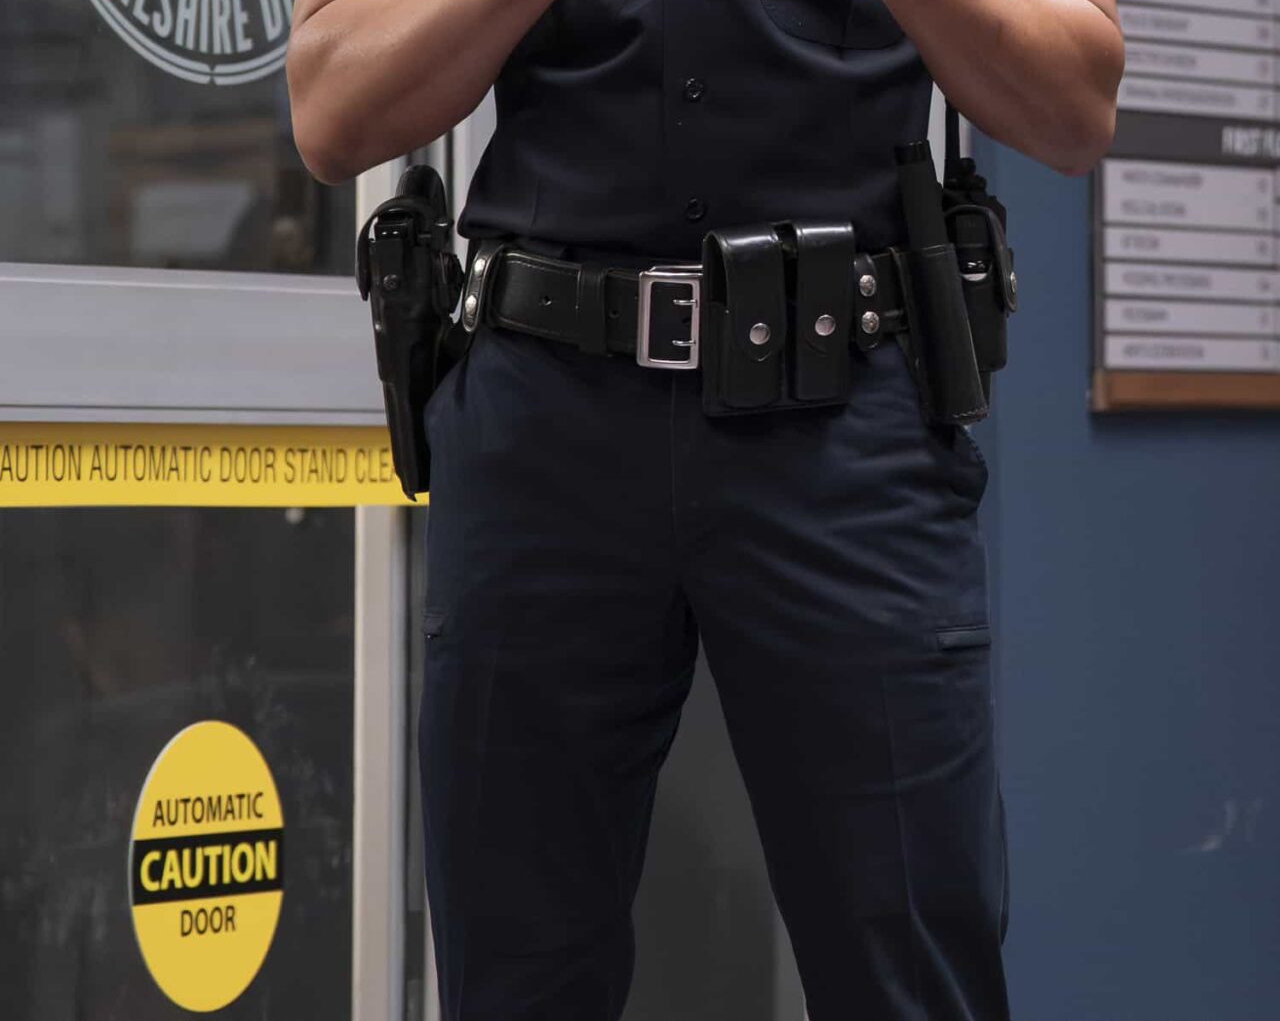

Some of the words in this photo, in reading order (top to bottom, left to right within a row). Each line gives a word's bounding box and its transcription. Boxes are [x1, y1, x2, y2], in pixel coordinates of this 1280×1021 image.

[0, 444, 81, 482] AUTION
[90, 444, 211, 482] AUTOMATIC
[219, 447, 276, 483] DOOR
[284, 448, 348, 483] STAND
[355, 448, 394, 483] CLE
[152, 792, 264, 827] AUTOMATIC
[140, 839, 277, 892] CAUTION
[180, 905, 236, 937] DOOR
